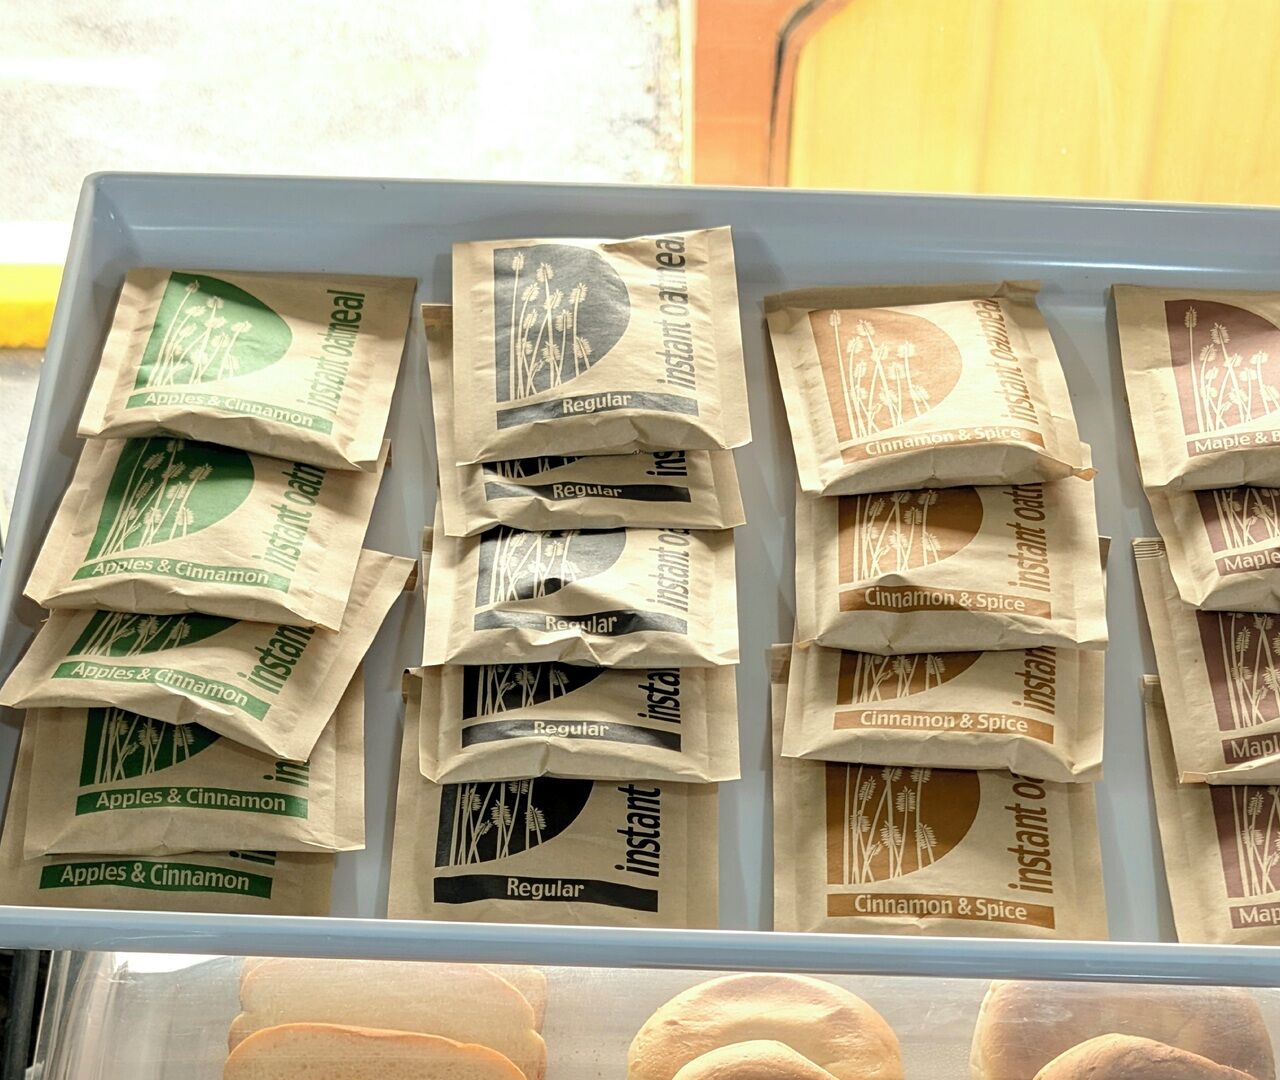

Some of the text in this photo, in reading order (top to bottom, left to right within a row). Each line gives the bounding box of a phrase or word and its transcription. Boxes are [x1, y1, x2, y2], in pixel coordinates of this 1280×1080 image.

[316, 290, 365, 357] oatmeal
[657, 319, 696, 390] instant
[563, 393, 631, 414] Regular
[986, 364, 1038, 424] instant
[145, 391, 313, 427] Apples & Cinnamon
[866, 428, 1021, 456] Cinnamon & Spice
[1195, 436, 1250, 453] Maple
[1255, 431, 1268, 442] &
[553, 484, 622, 498] Regular
[252, 505, 312, 572] instant
[1008, 523, 1050, 592] instant
[1224, 554, 1280, 572] Maple
[92, 558, 269, 584] Apples & Cinnamon
[646, 546, 688, 612] instant
[865, 588, 1025, 612] Cinnamon & Spice
[546, 615, 617, 633] Regular
[72, 663, 248, 706] Apples & Cinnamon
[534, 722, 609, 737] Regular
[860, 712, 1028, 732] Cinnamon & Spice
[96, 789, 286, 811] Apples & Cinnamon
[615, 785, 660, 877] instant
[1005, 805, 1053, 893] instant
[61, 863, 249, 890] Apples & Cinnamon
[507, 878, 584, 899] Regular
[855, 896, 1027, 919] Cinnamon & Spice
